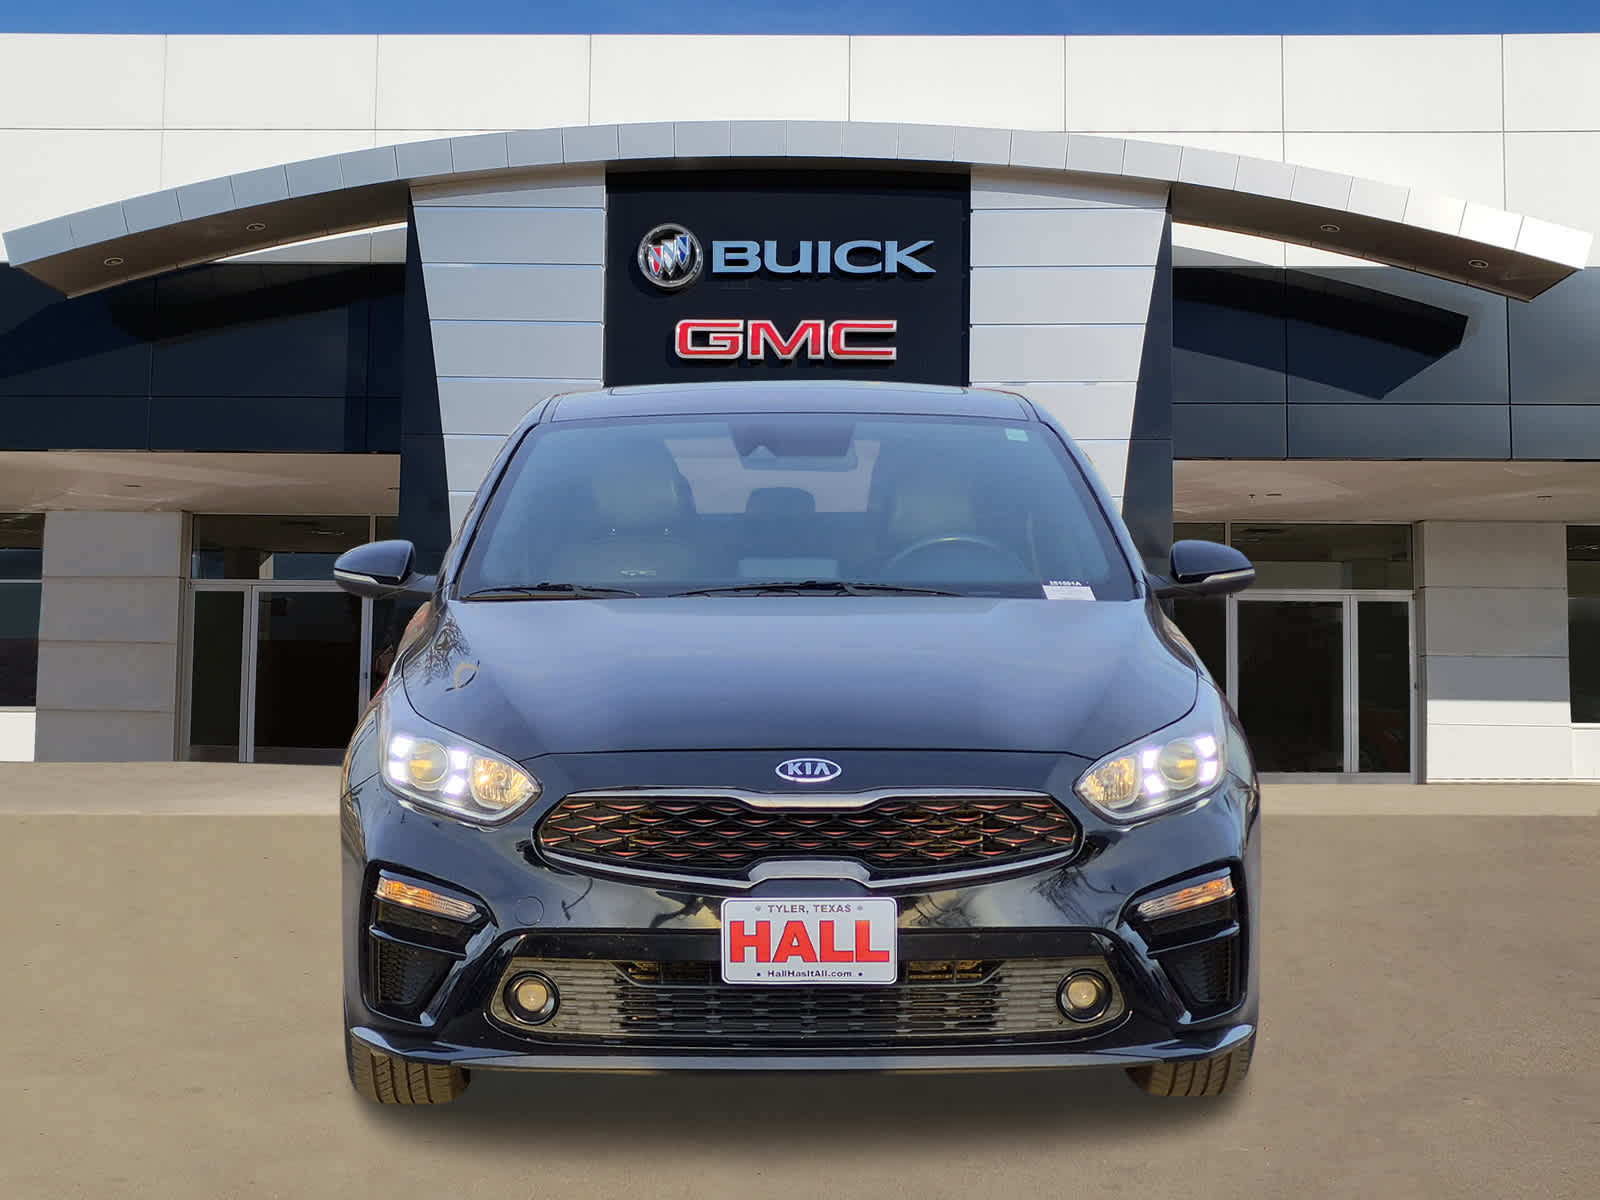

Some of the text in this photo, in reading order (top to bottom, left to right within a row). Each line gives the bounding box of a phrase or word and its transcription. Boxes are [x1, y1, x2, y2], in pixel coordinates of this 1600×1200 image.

[712, 240, 936, 273] BUICK
[675, 319, 897, 360] GMC
[787, 762, 830, 775] KIA
[768, 904, 851, 914] TYLER, TEXAS
[729, 919, 890, 963] HALL
[768, 969, 852, 978] HallHasItAll.com
